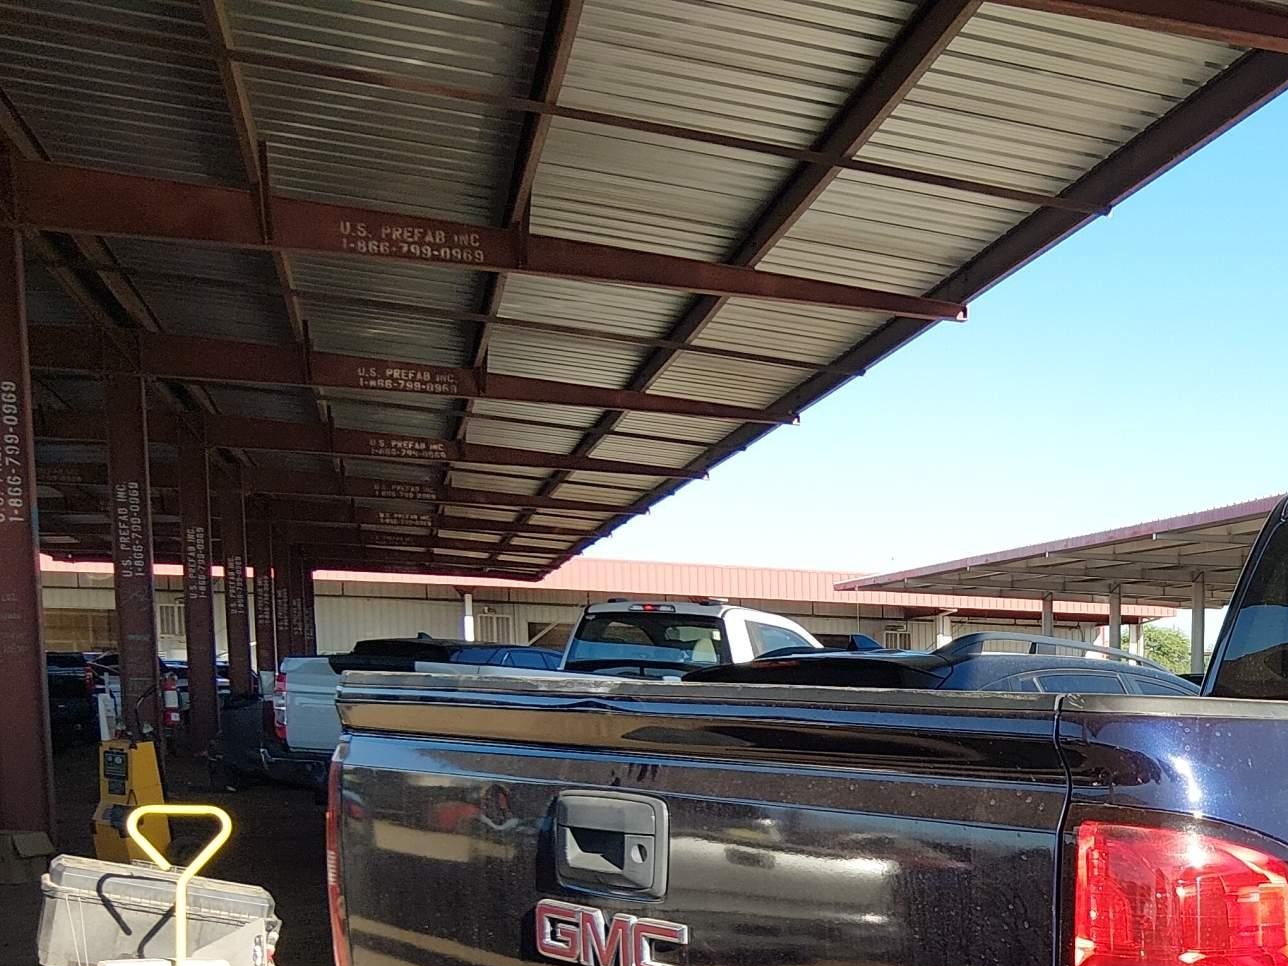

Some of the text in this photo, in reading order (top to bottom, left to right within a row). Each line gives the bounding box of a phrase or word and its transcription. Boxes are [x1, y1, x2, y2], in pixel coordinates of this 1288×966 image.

[339, 220, 372, 238] U.S.
[381, 223, 446, 244] PREFAB
[342, 237, 485, 263] 1-866-799-0969
[385, 368, 431, 381] PREFAB
[1, 381, 25, 522] 1-866-799-0969
